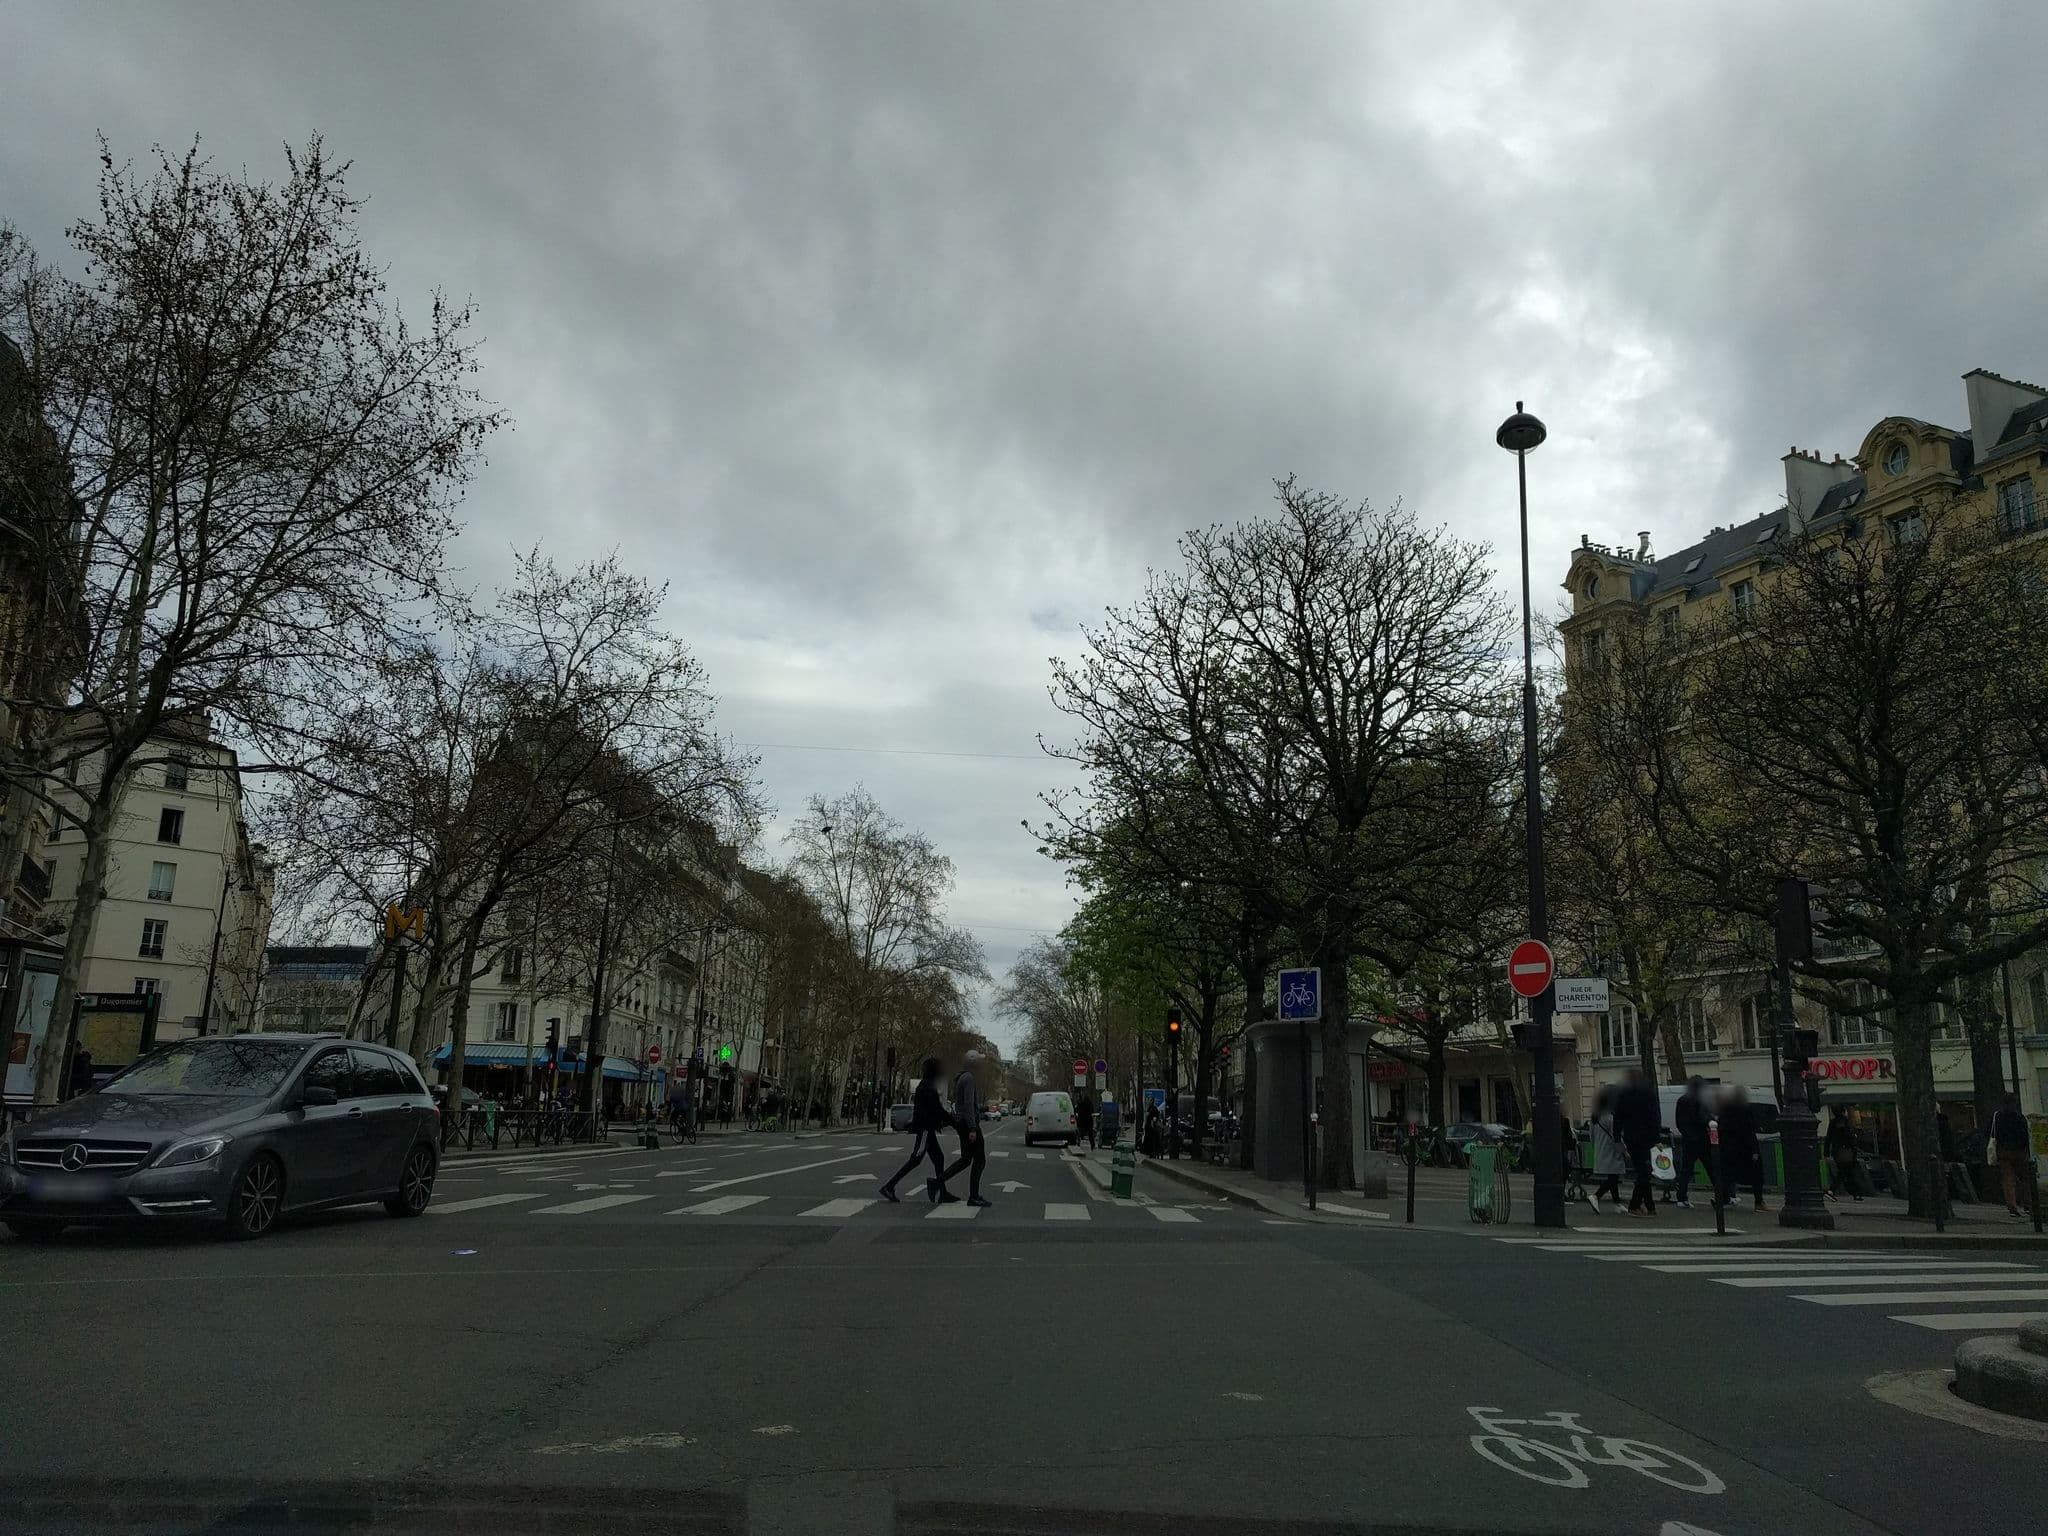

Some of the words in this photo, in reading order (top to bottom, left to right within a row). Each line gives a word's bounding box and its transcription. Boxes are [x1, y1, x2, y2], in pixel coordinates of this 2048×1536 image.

[386, 905, 423, 940] M
[101, 997, 143, 1006] Dugommier
[1801, 1058, 1896, 1080] ONOPR
